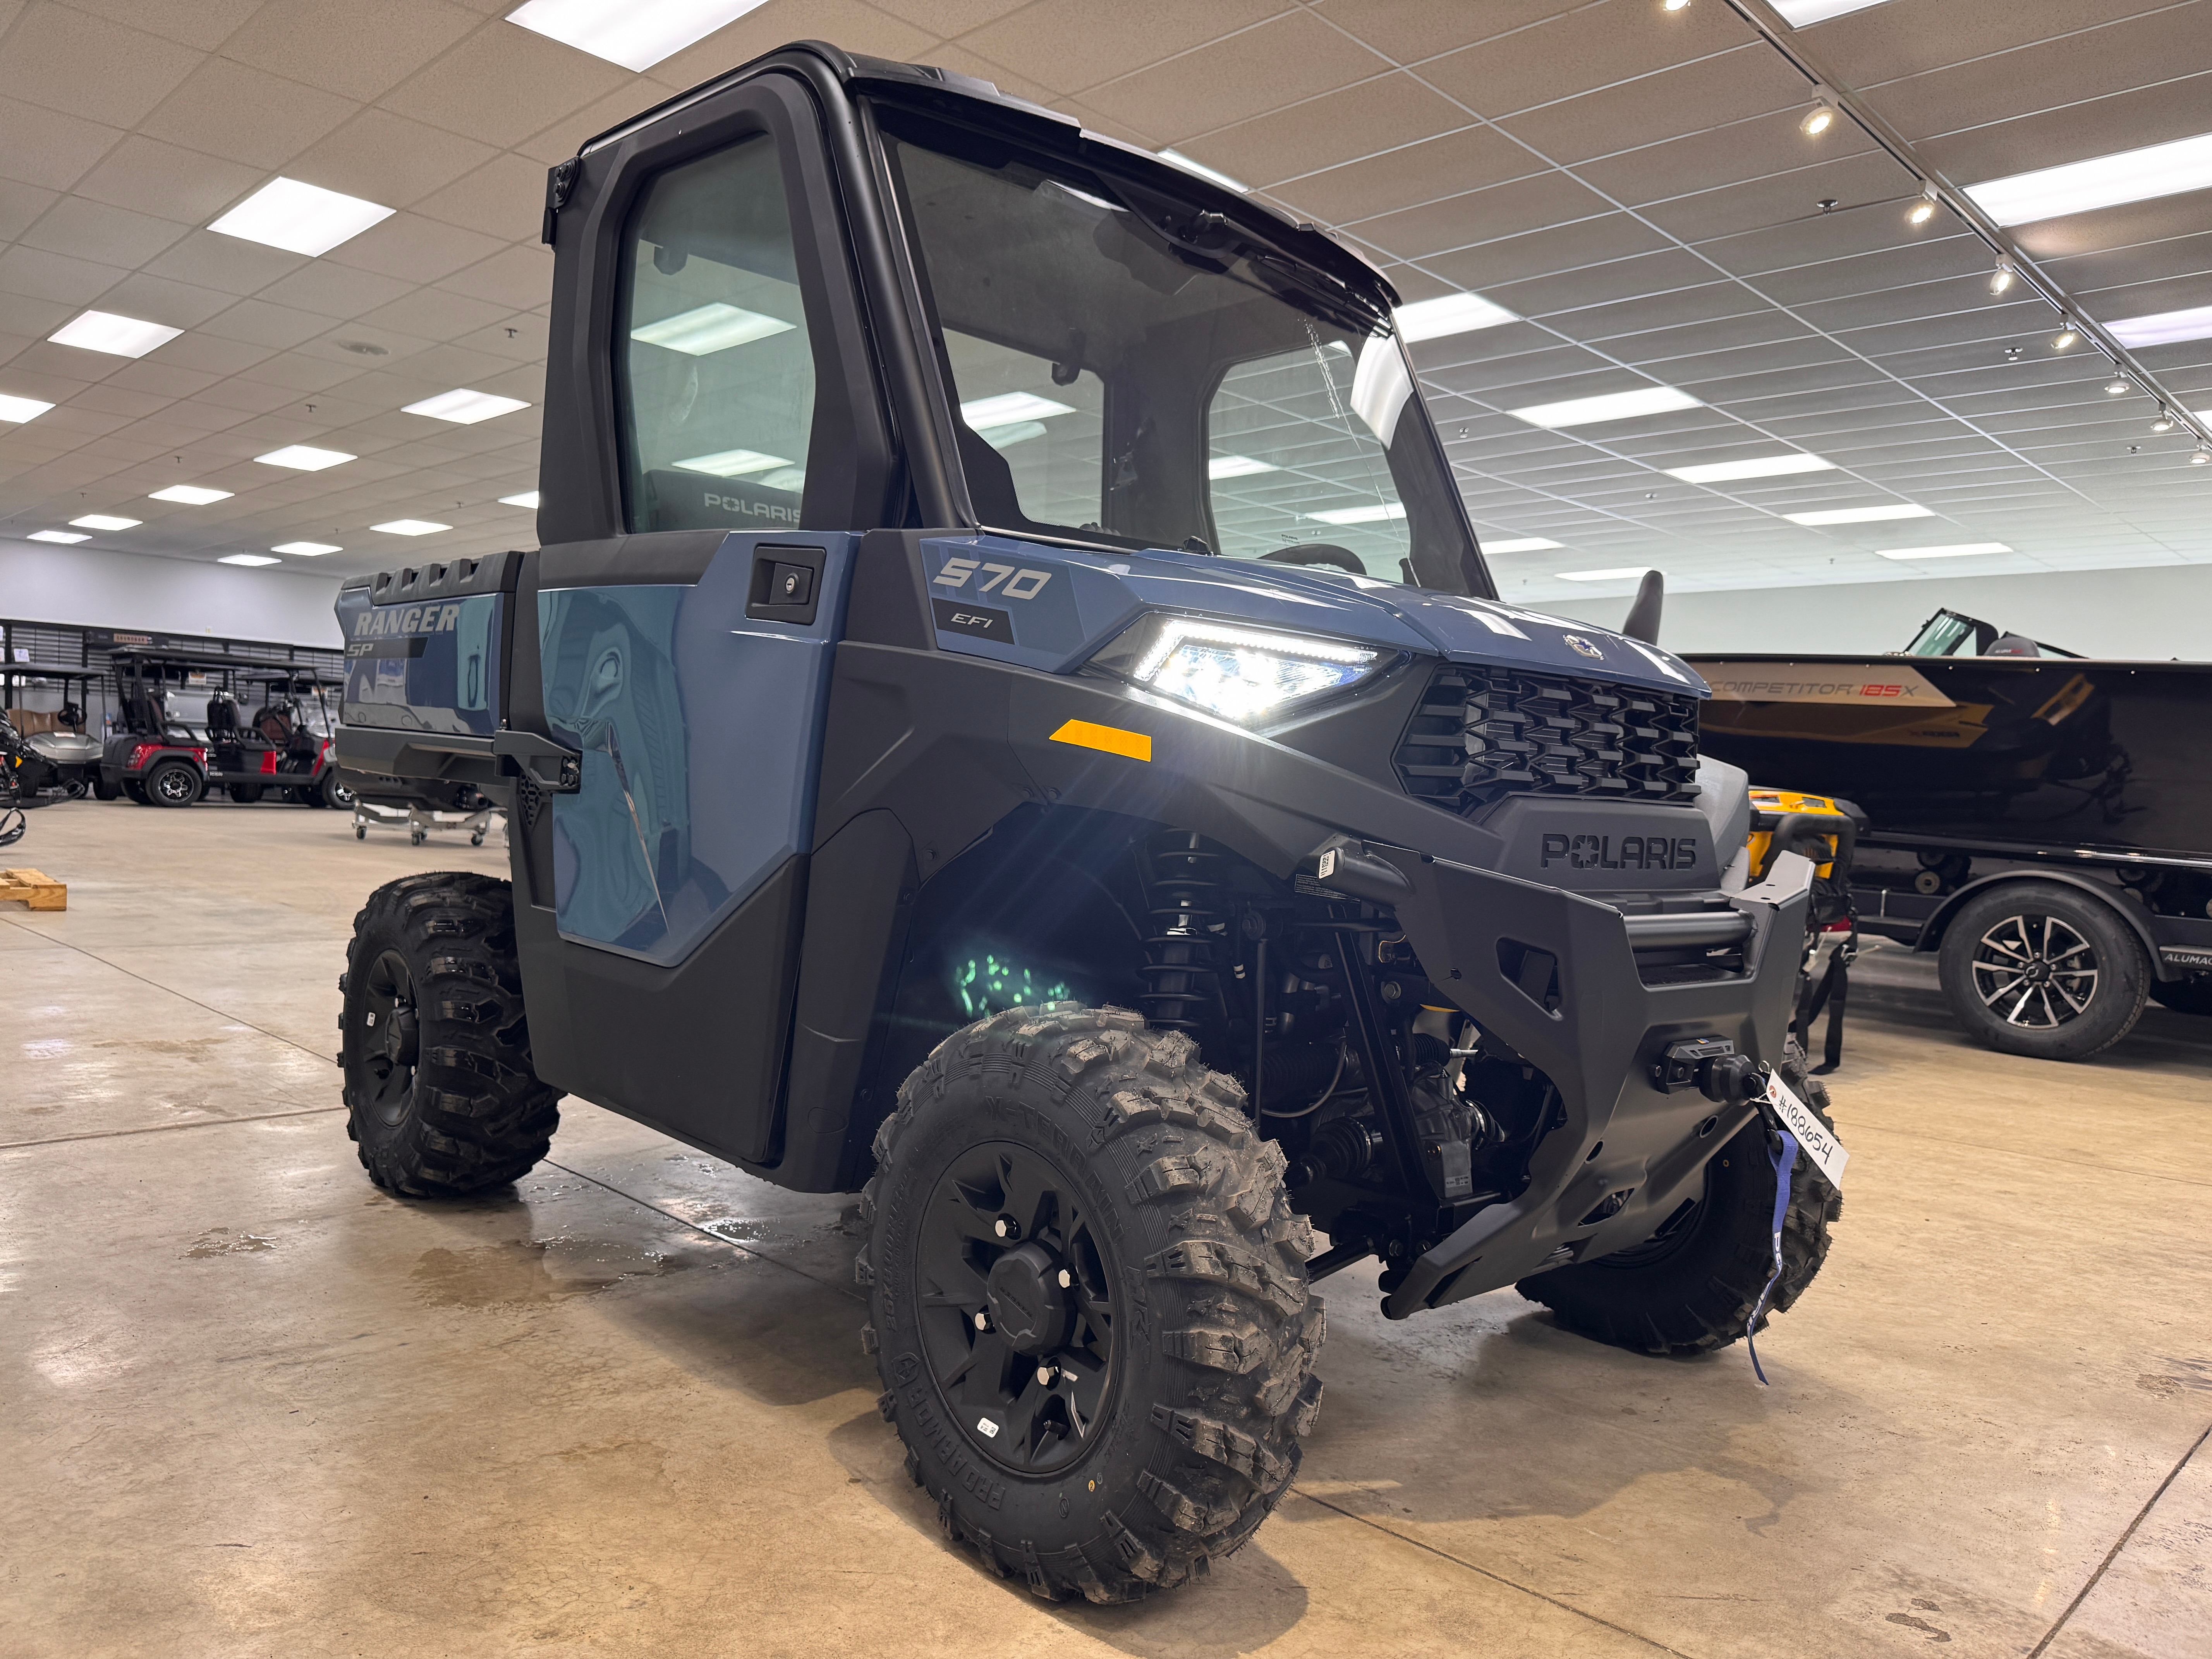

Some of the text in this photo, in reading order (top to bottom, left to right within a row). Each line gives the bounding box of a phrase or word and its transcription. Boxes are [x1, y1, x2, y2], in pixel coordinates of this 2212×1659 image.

[704, 493, 801, 523] POLARIS
[933, 557, 1052, 600] 570
[354, 605, 460, 637] RANGER
[951, 613, 993, 628] EFI
[347, 642, 374, 657] SP
[1709, 680, 1919, 697] COMPETITOR 185X
[1541, 833, 1696, 871] POLARIS
[1779, 1095, 1833, 1165] #188654
[907, 1387, 1006, 1510] PRO ARMOR
